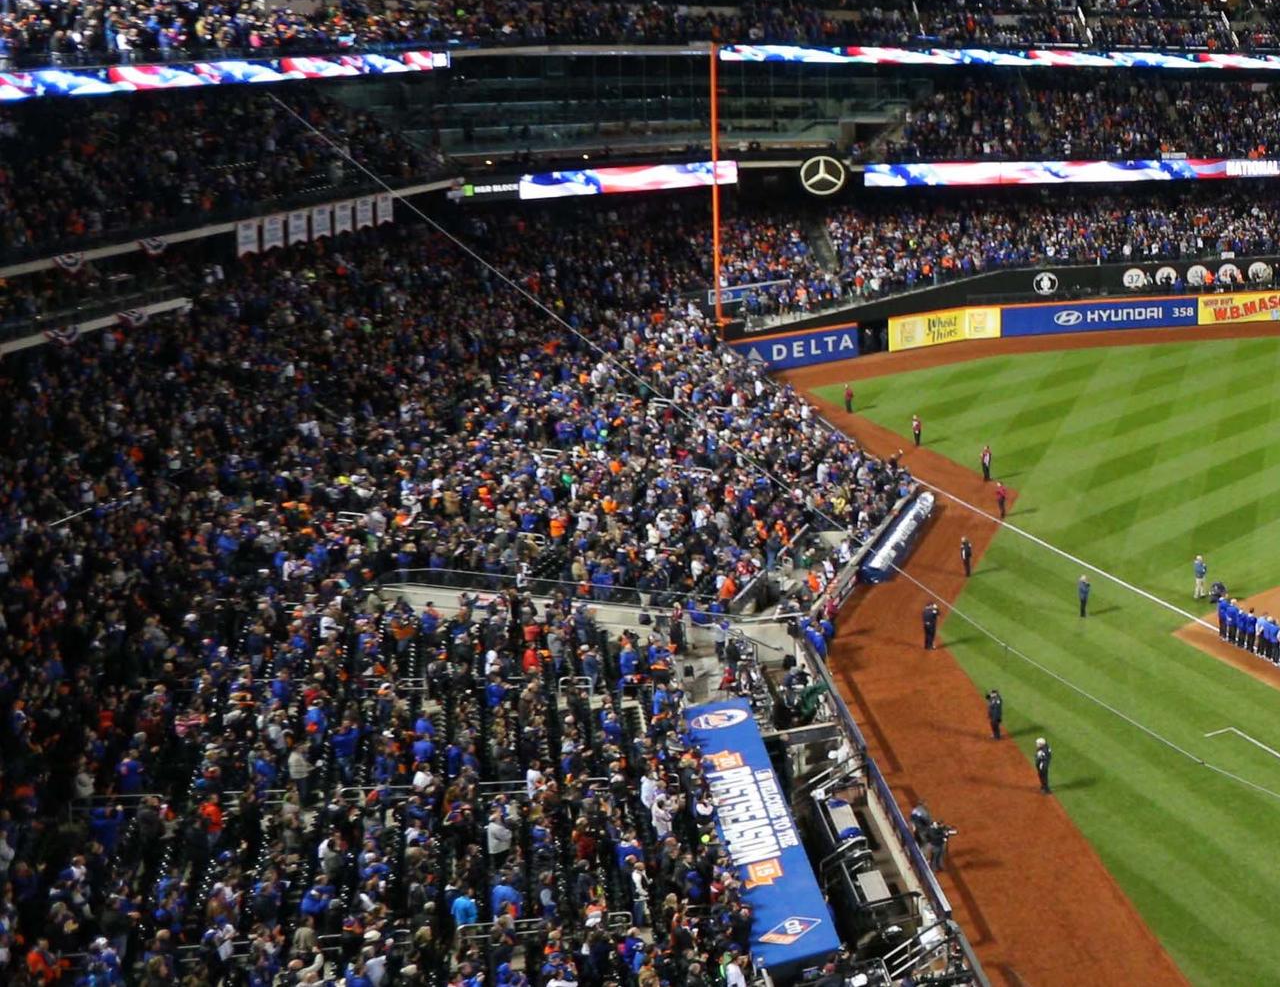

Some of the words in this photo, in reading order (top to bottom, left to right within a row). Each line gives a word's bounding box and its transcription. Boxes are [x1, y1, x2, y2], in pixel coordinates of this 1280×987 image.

[1226, 160, 1280, 176] NATIONAL
[1127, 274, 1140, 284] 37
[1087, 307, 1163, 322] HYUNDAI
[1172, 306, 1194, 318] 358
[928, 316, 958, 332] Wheat
[772, 334, 854, 361] DELTA
[758, 779, 789, 815] WELCOME
[704, 766, 783, 866] POSTSEASON
